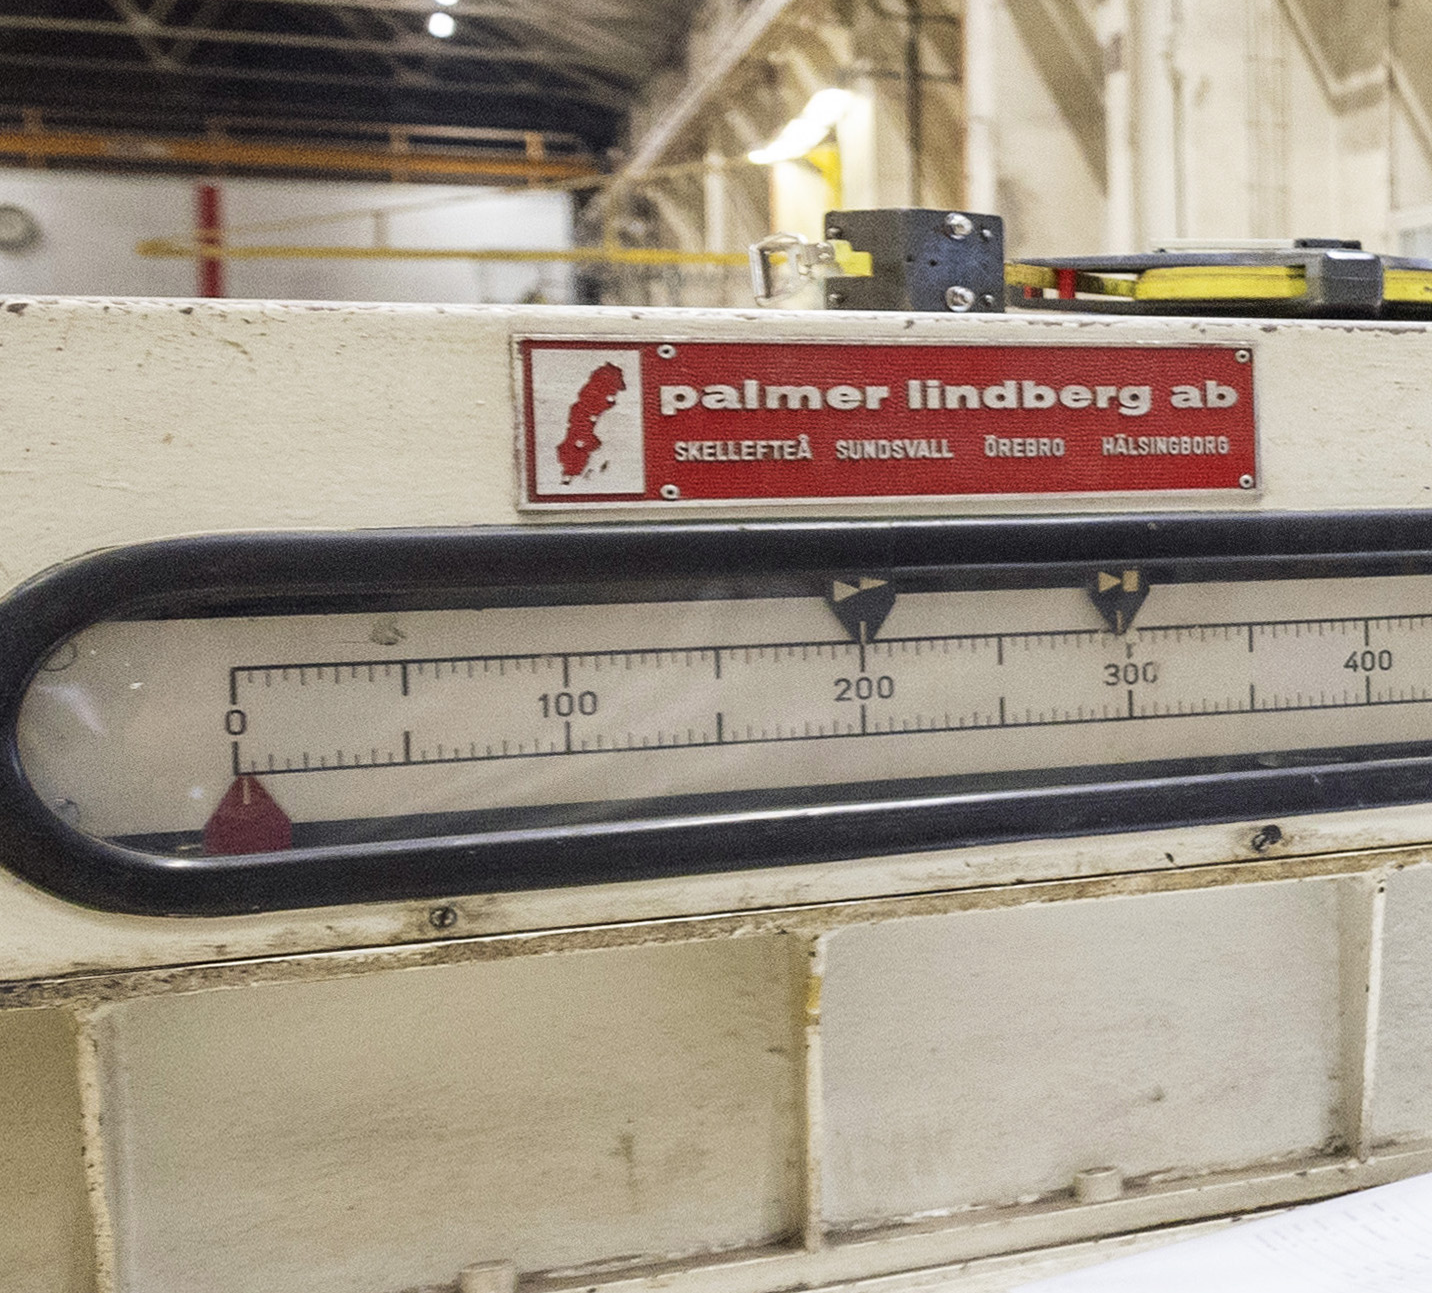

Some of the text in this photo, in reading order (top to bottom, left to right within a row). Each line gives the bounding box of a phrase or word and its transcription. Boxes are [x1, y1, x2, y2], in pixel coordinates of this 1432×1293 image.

[659, 379, 1239, 416] palmer lindberg ab
[674, 434, 1230, 461] SKELLEFTEÅ SUNDSVALL ÖREBRO HÄLSINGBORG
[1103, 661, 1158, 685] 300
[1343, 649, 1393, 672] 400
[834, 675, 895, 701] 200
[538, 690, 599, 718] 100
[224, 708, 247, 736] 0
